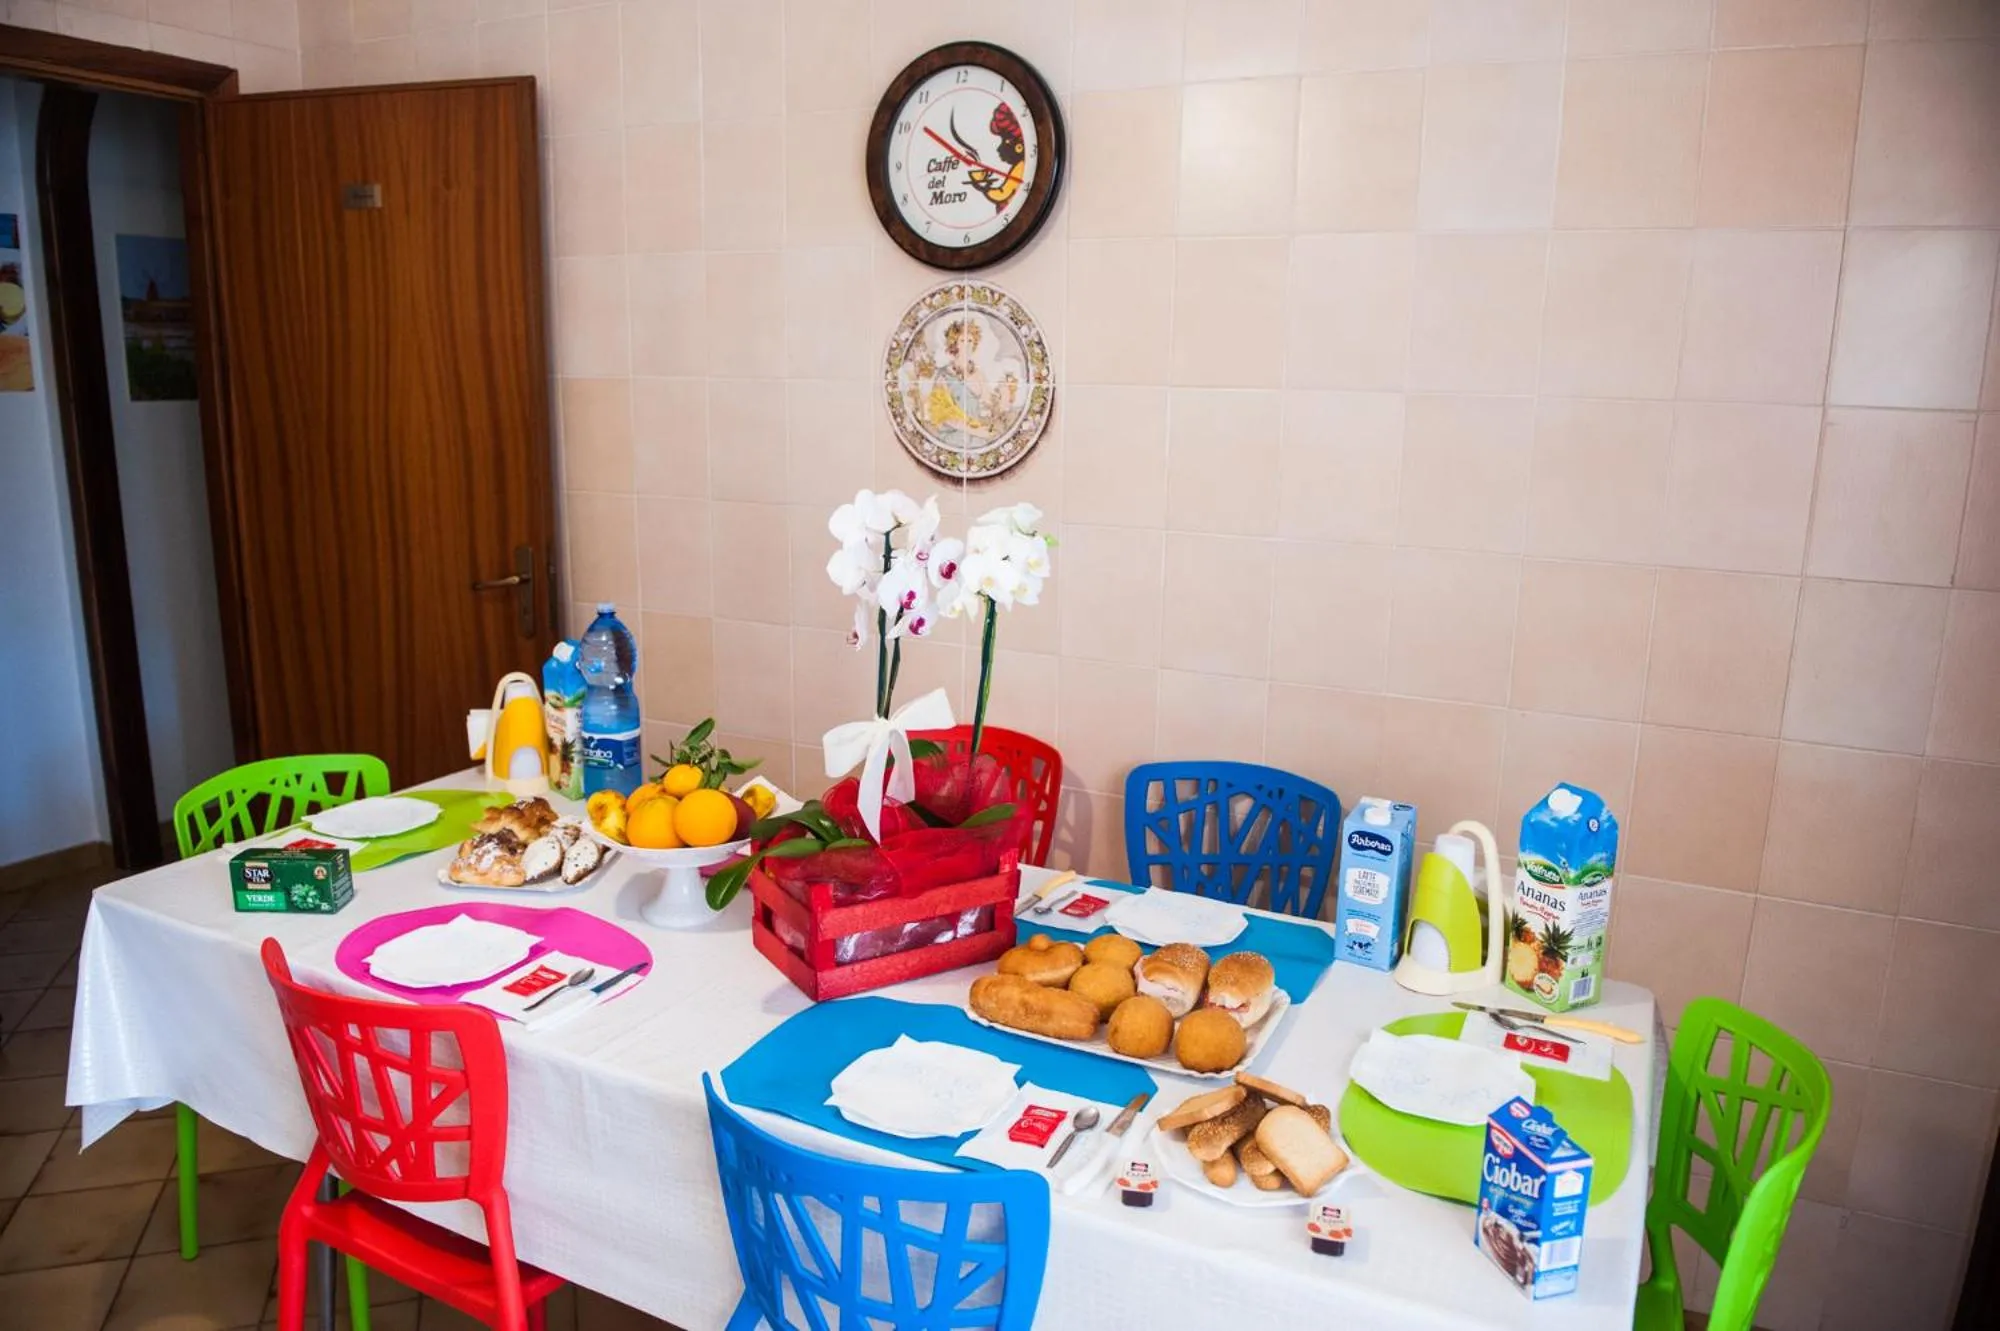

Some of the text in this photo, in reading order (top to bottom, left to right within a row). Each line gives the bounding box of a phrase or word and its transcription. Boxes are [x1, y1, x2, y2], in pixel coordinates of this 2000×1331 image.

[955, 70, 968, 84] 12
[918, 91, 930, 104] 11
[898, 121, 911, 135] 10
[927, 175, 946, 189] del
[928, 190, 967, 206] Moro
[1002, 214, 1010, 227] 5
[963, 232, 971, 244] 6
[1351, 834, 1392, 852] Arborea
[245, 868, 271, 878] STAR
[1517, 880, 1567, 912] Ananas
[1578, 888, 1608, 901] Ananas
[1483, 1152, 1546, 1199] Ciobar
